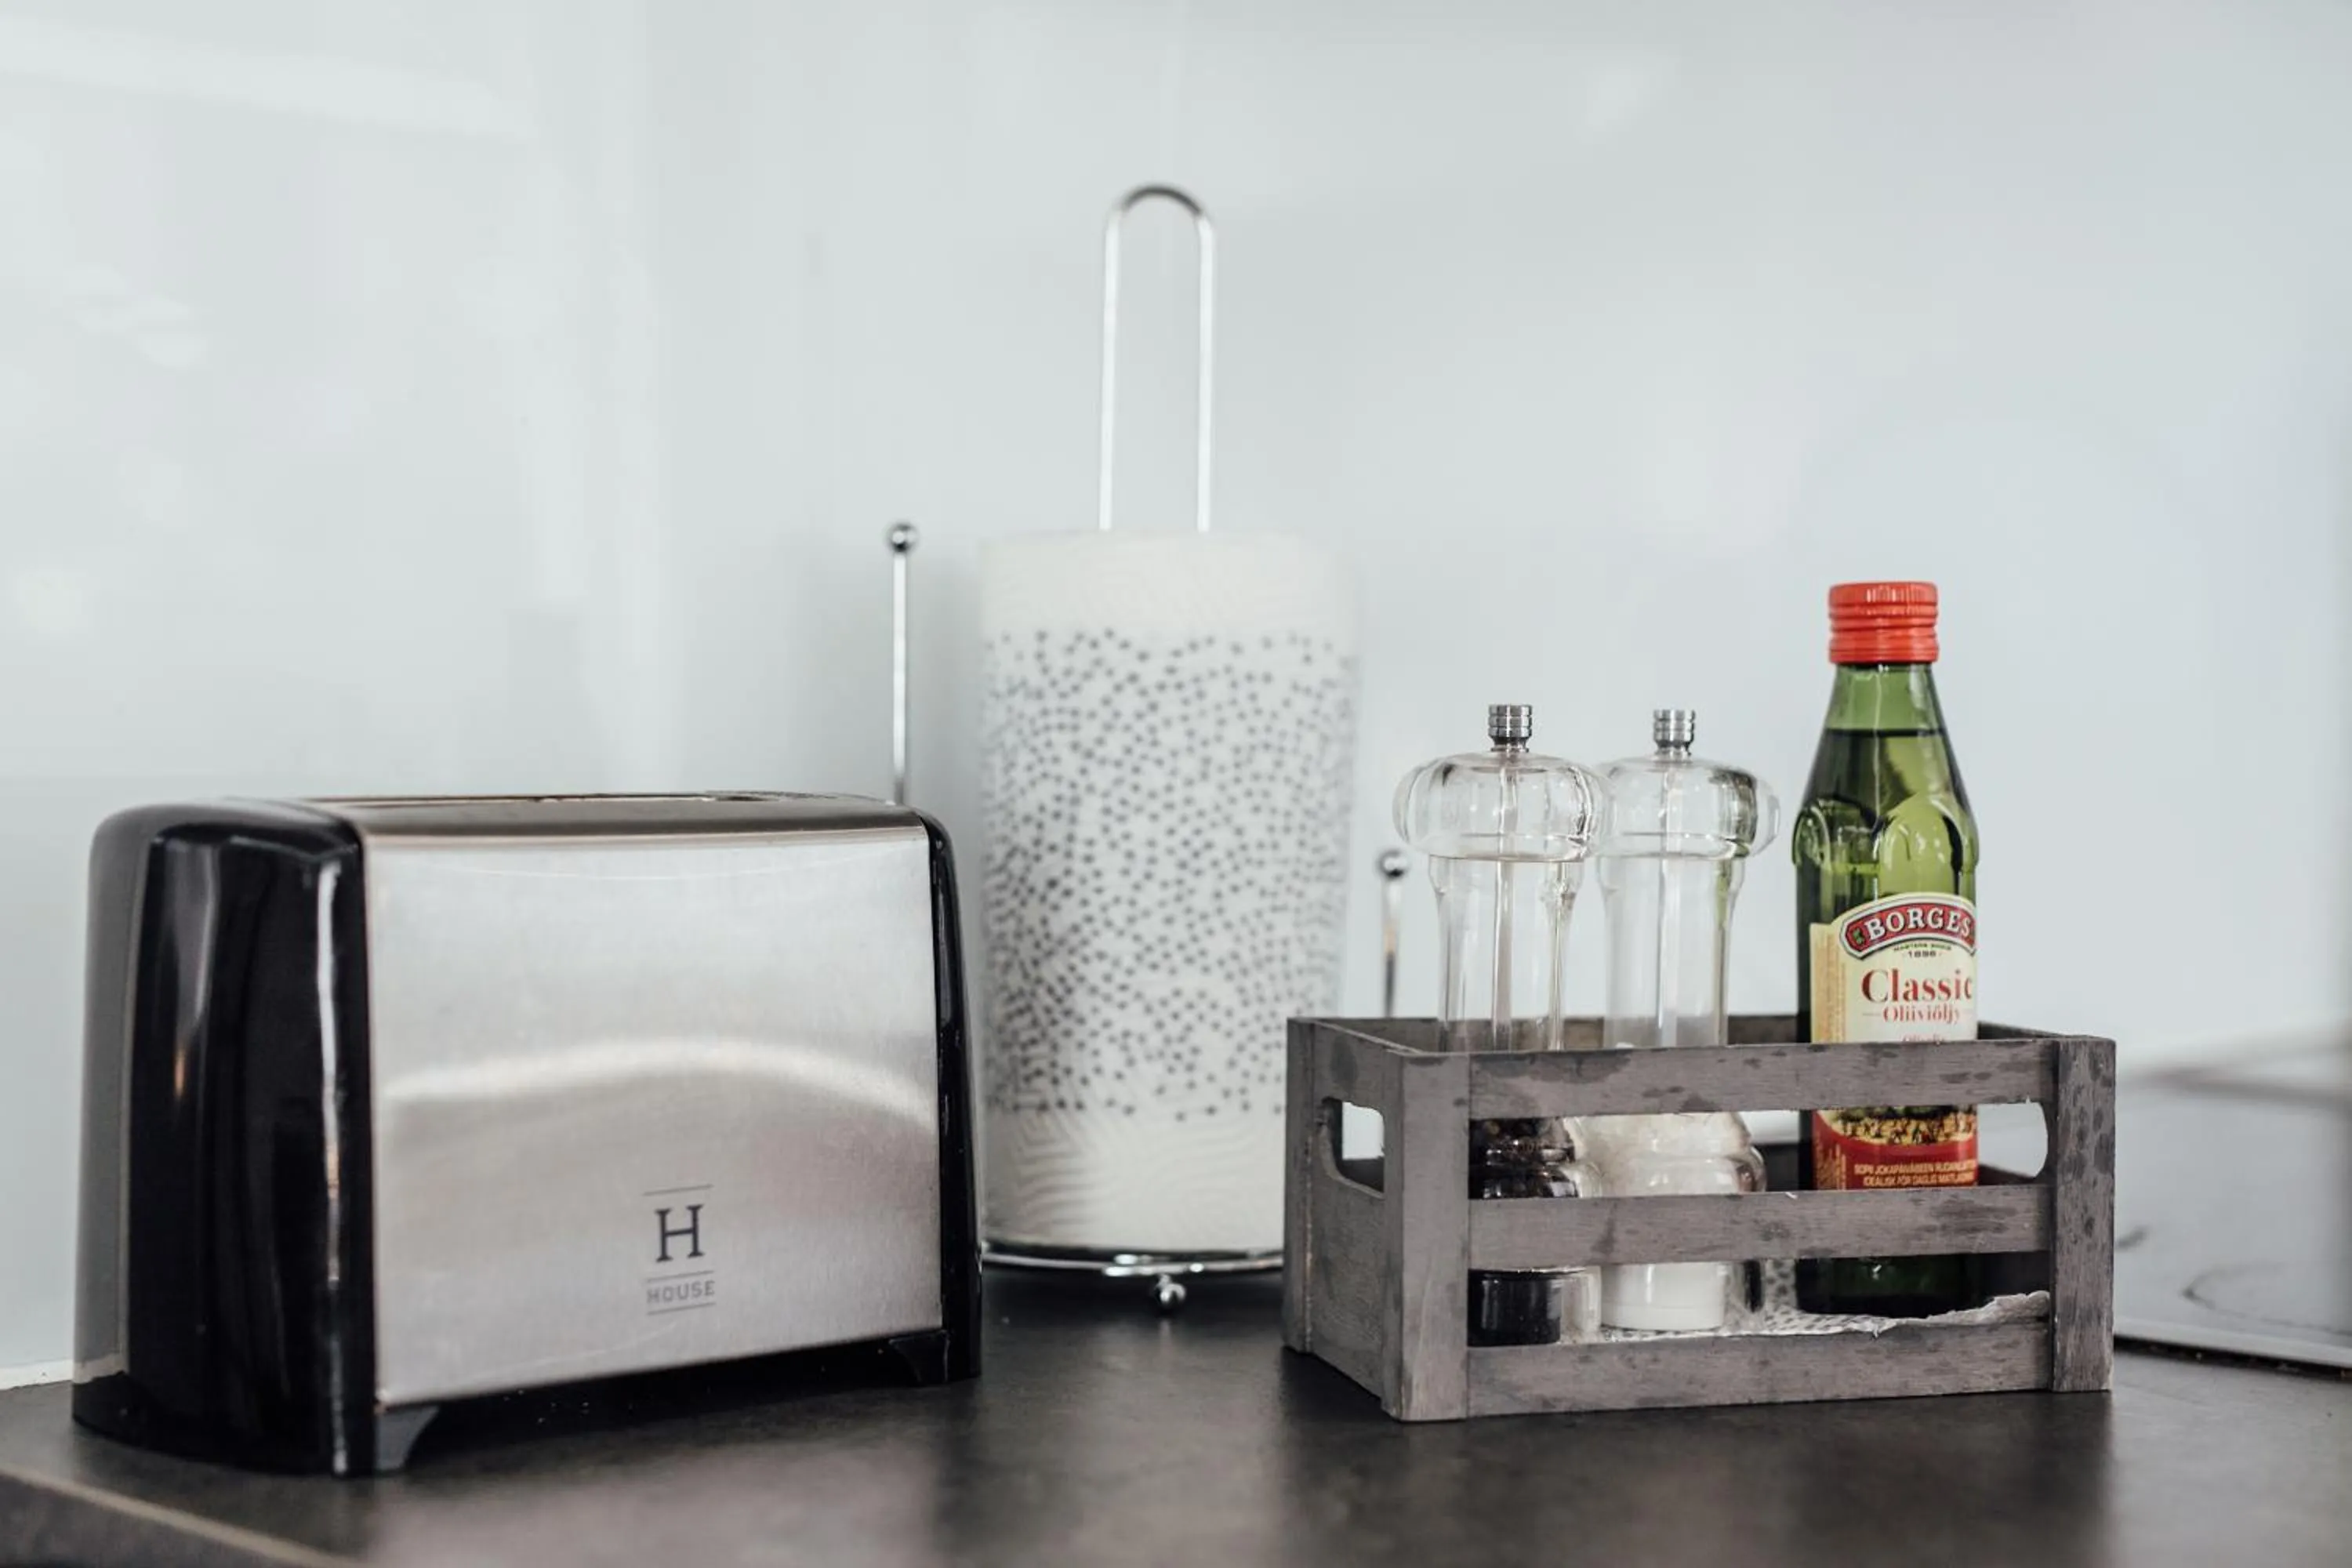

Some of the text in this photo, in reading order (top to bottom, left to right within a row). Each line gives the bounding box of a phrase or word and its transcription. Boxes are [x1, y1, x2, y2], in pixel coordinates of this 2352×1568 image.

[1864, 907, 1972, 942] BORGES
[1861, 968, 1973, 1003] Classic
[655, 1203, 706, 1263] H
[646, 1279, 716, 1304] HOUSE
